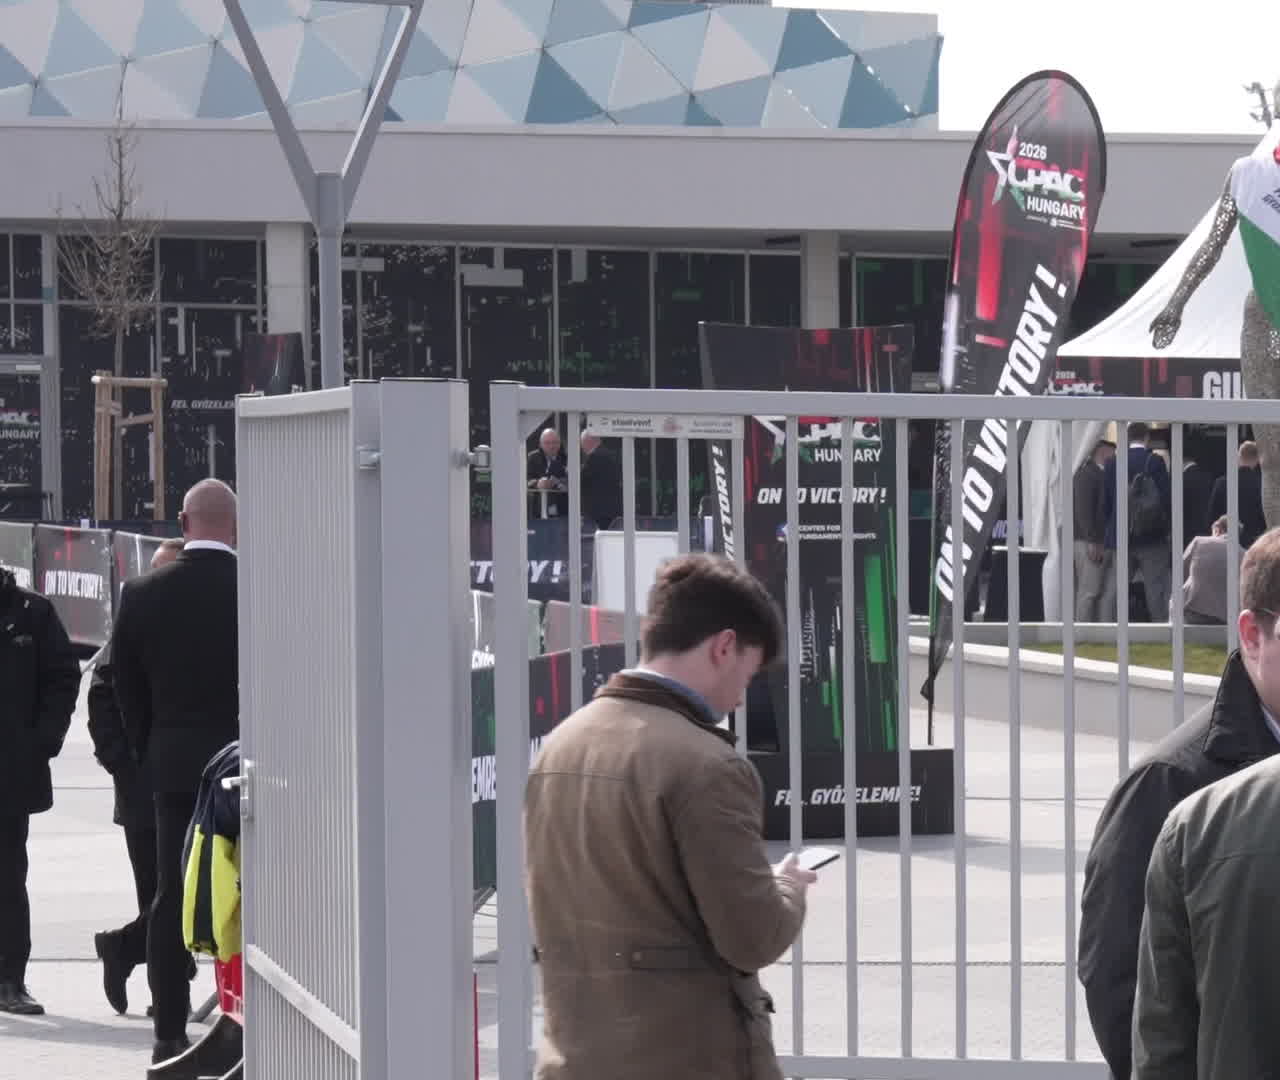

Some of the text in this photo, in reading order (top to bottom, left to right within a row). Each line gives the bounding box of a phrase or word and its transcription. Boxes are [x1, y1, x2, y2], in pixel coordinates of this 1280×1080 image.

[1018, 142, 1048, 160] 2026
[1026, 196, 1087, 220] HUNGARY
[815, 448, 881, 462] HUNARY
[757, 487, 783, 505] ON
[44, 570, 57, 596] ON
[58, 570, 68, 596] TO
